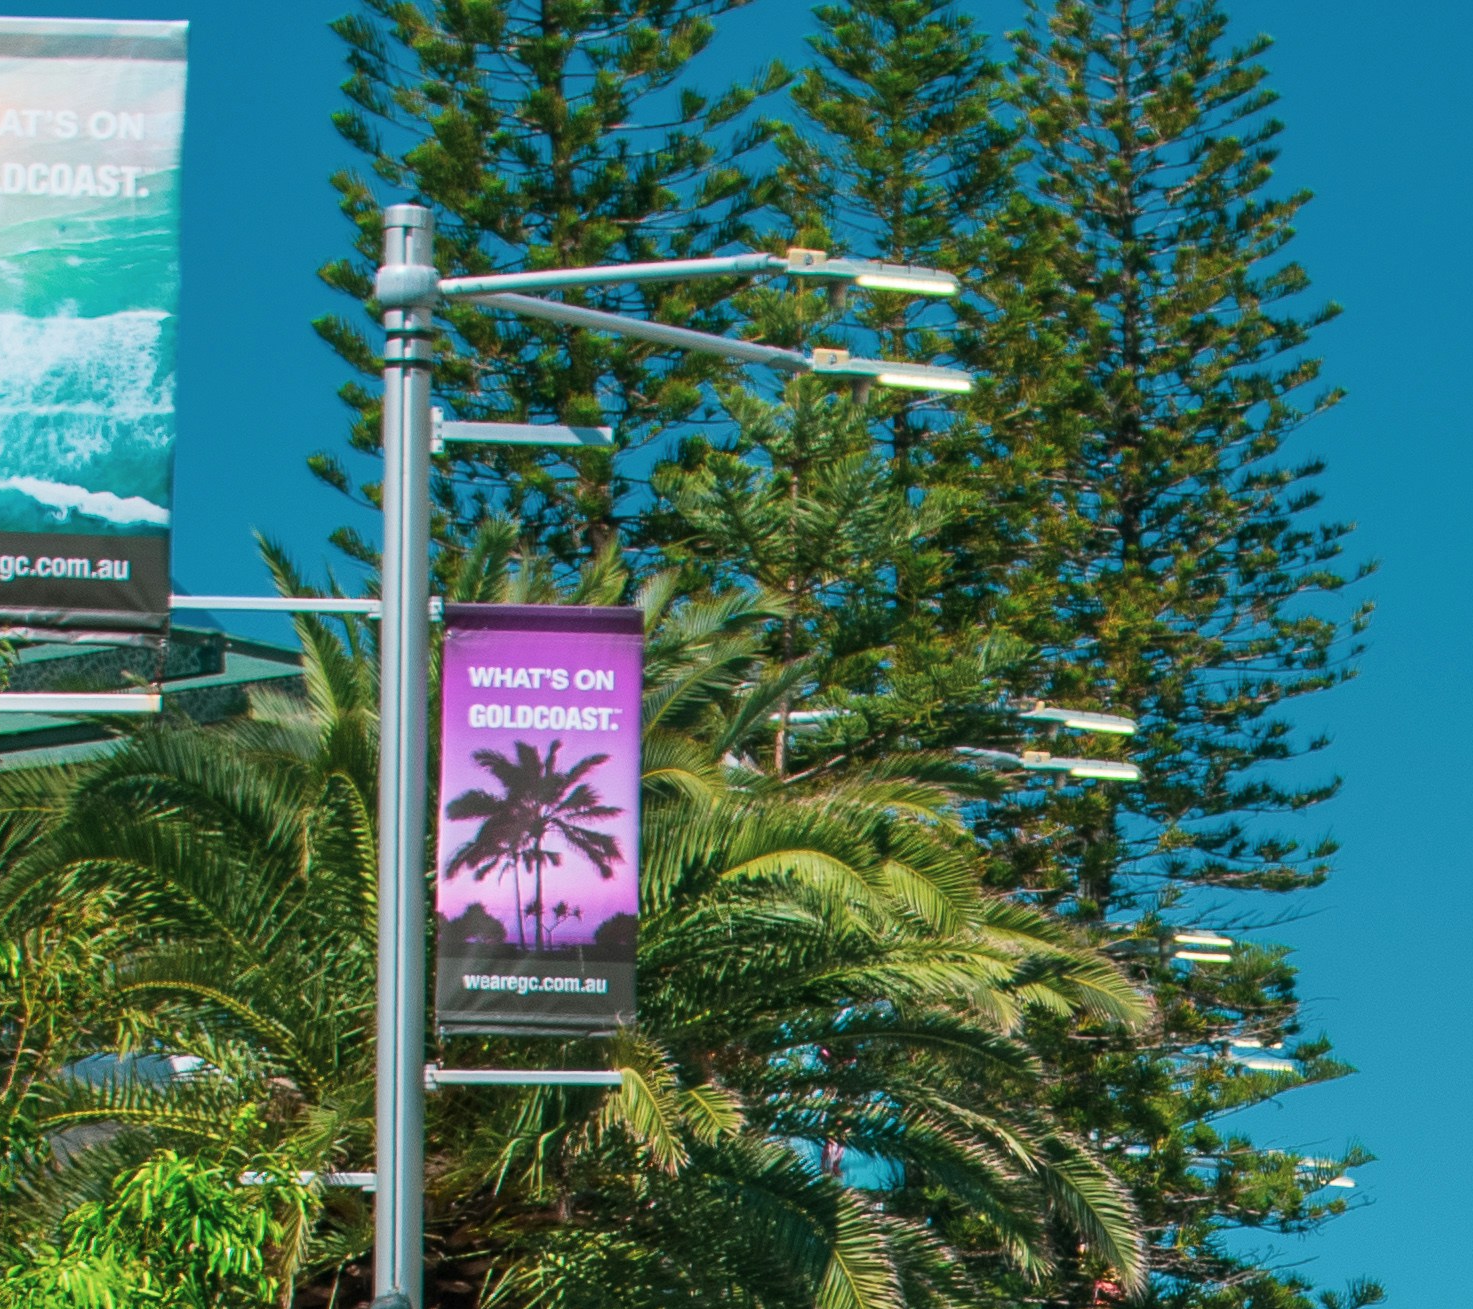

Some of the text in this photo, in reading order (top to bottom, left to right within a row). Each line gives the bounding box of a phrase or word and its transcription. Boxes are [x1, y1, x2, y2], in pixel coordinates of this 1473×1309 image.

[88, 110, 145, 141] ON
[468, 667, 615, 691] WHAT'S ON
[463, 974, 608, 995] wearegc.com.au
